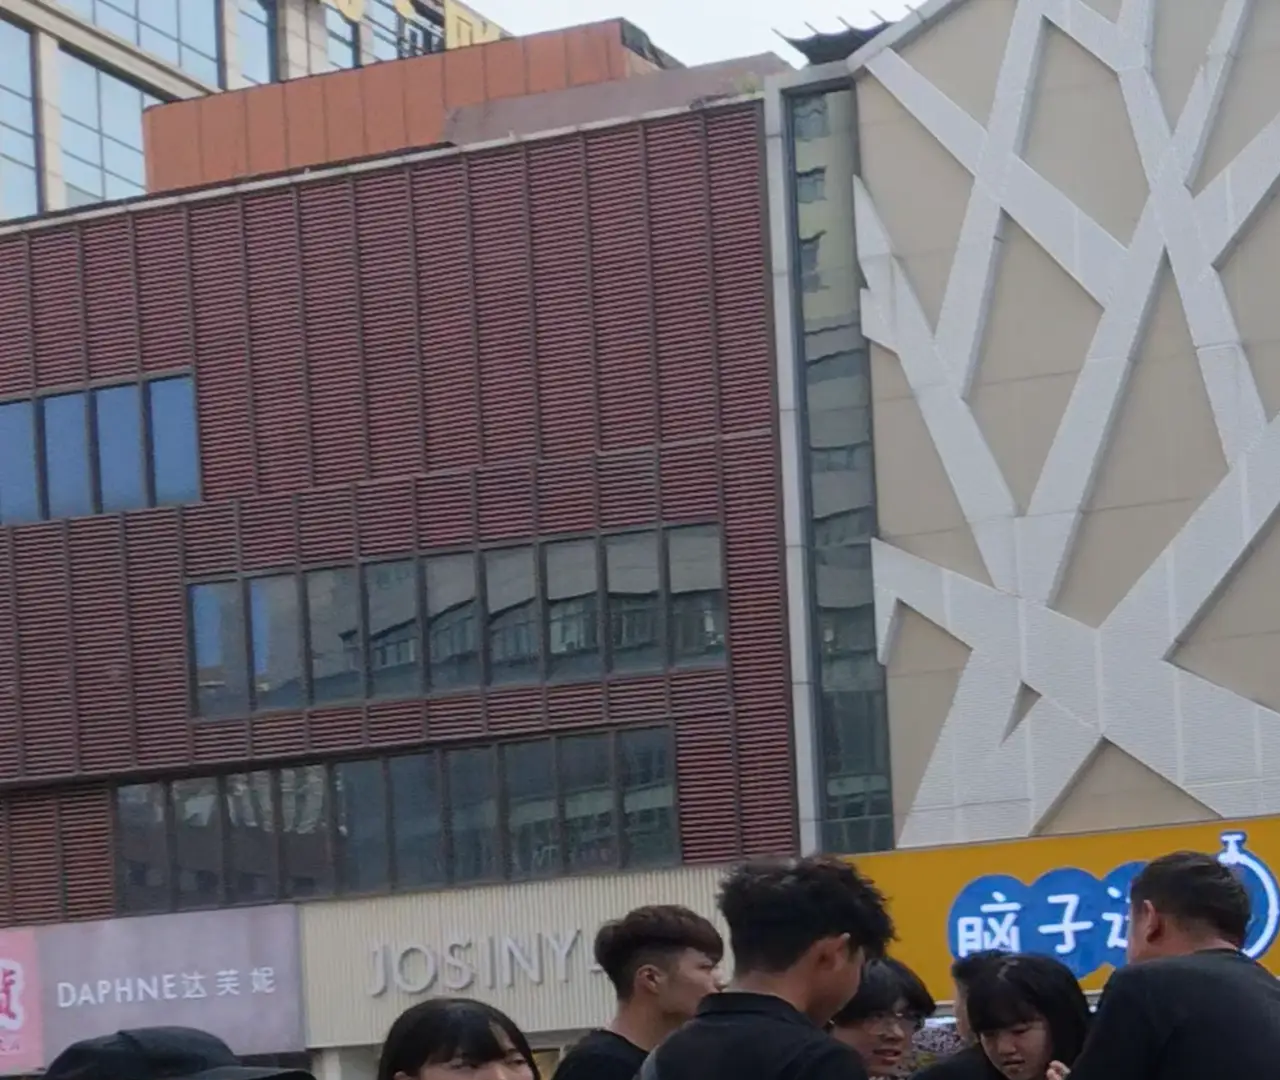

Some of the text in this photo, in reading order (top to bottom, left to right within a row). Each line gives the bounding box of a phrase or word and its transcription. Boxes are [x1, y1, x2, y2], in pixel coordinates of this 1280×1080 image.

[371, 928, 581, 997] JOSINY
[57, 974, 177, 1008] DAPHNE
[181, 966, 276, 999] 达芙妮
